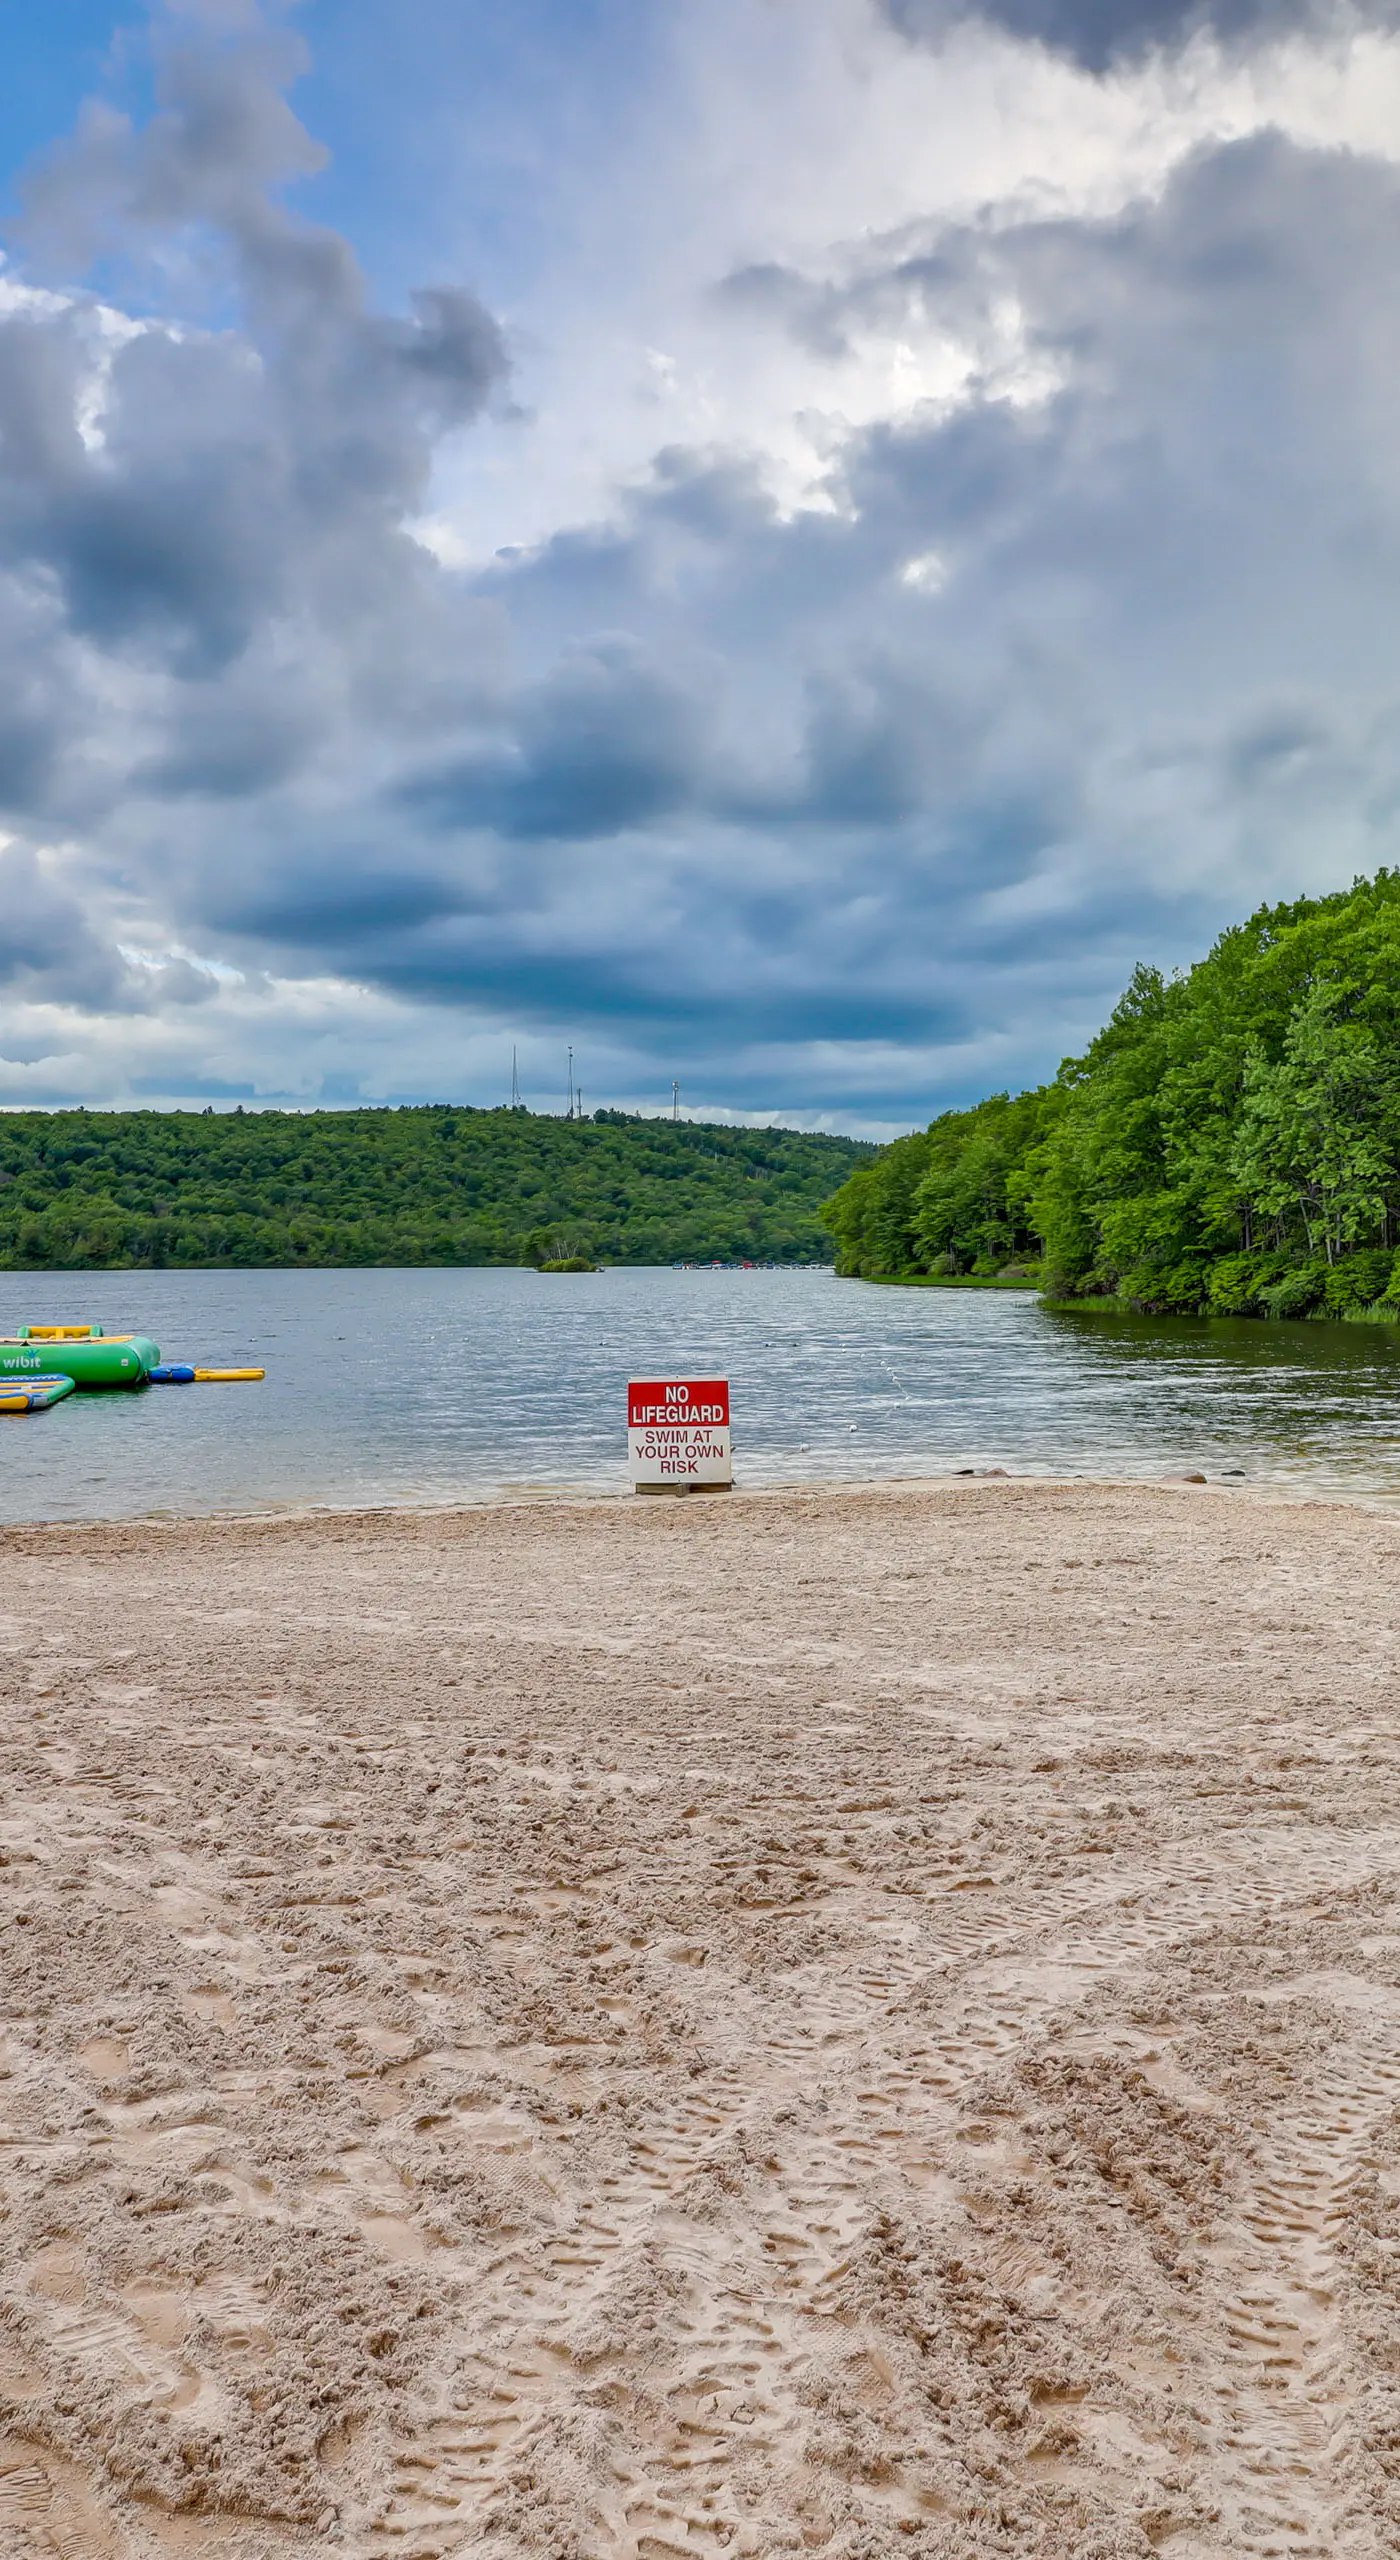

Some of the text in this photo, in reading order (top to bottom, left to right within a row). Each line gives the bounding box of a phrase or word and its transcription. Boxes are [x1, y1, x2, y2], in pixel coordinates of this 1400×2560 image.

[3, 1354, 42, 1369] wibit
[665, 1385, 690, 1403] NO
[632, 1405, 724, 1423] LIFEGUARD
[645, 1430, 713, 1444] SWIM AT
[635, 1445, 724, 1459] YOUR OWN
[660, 1460, 699, 1474] RISK
